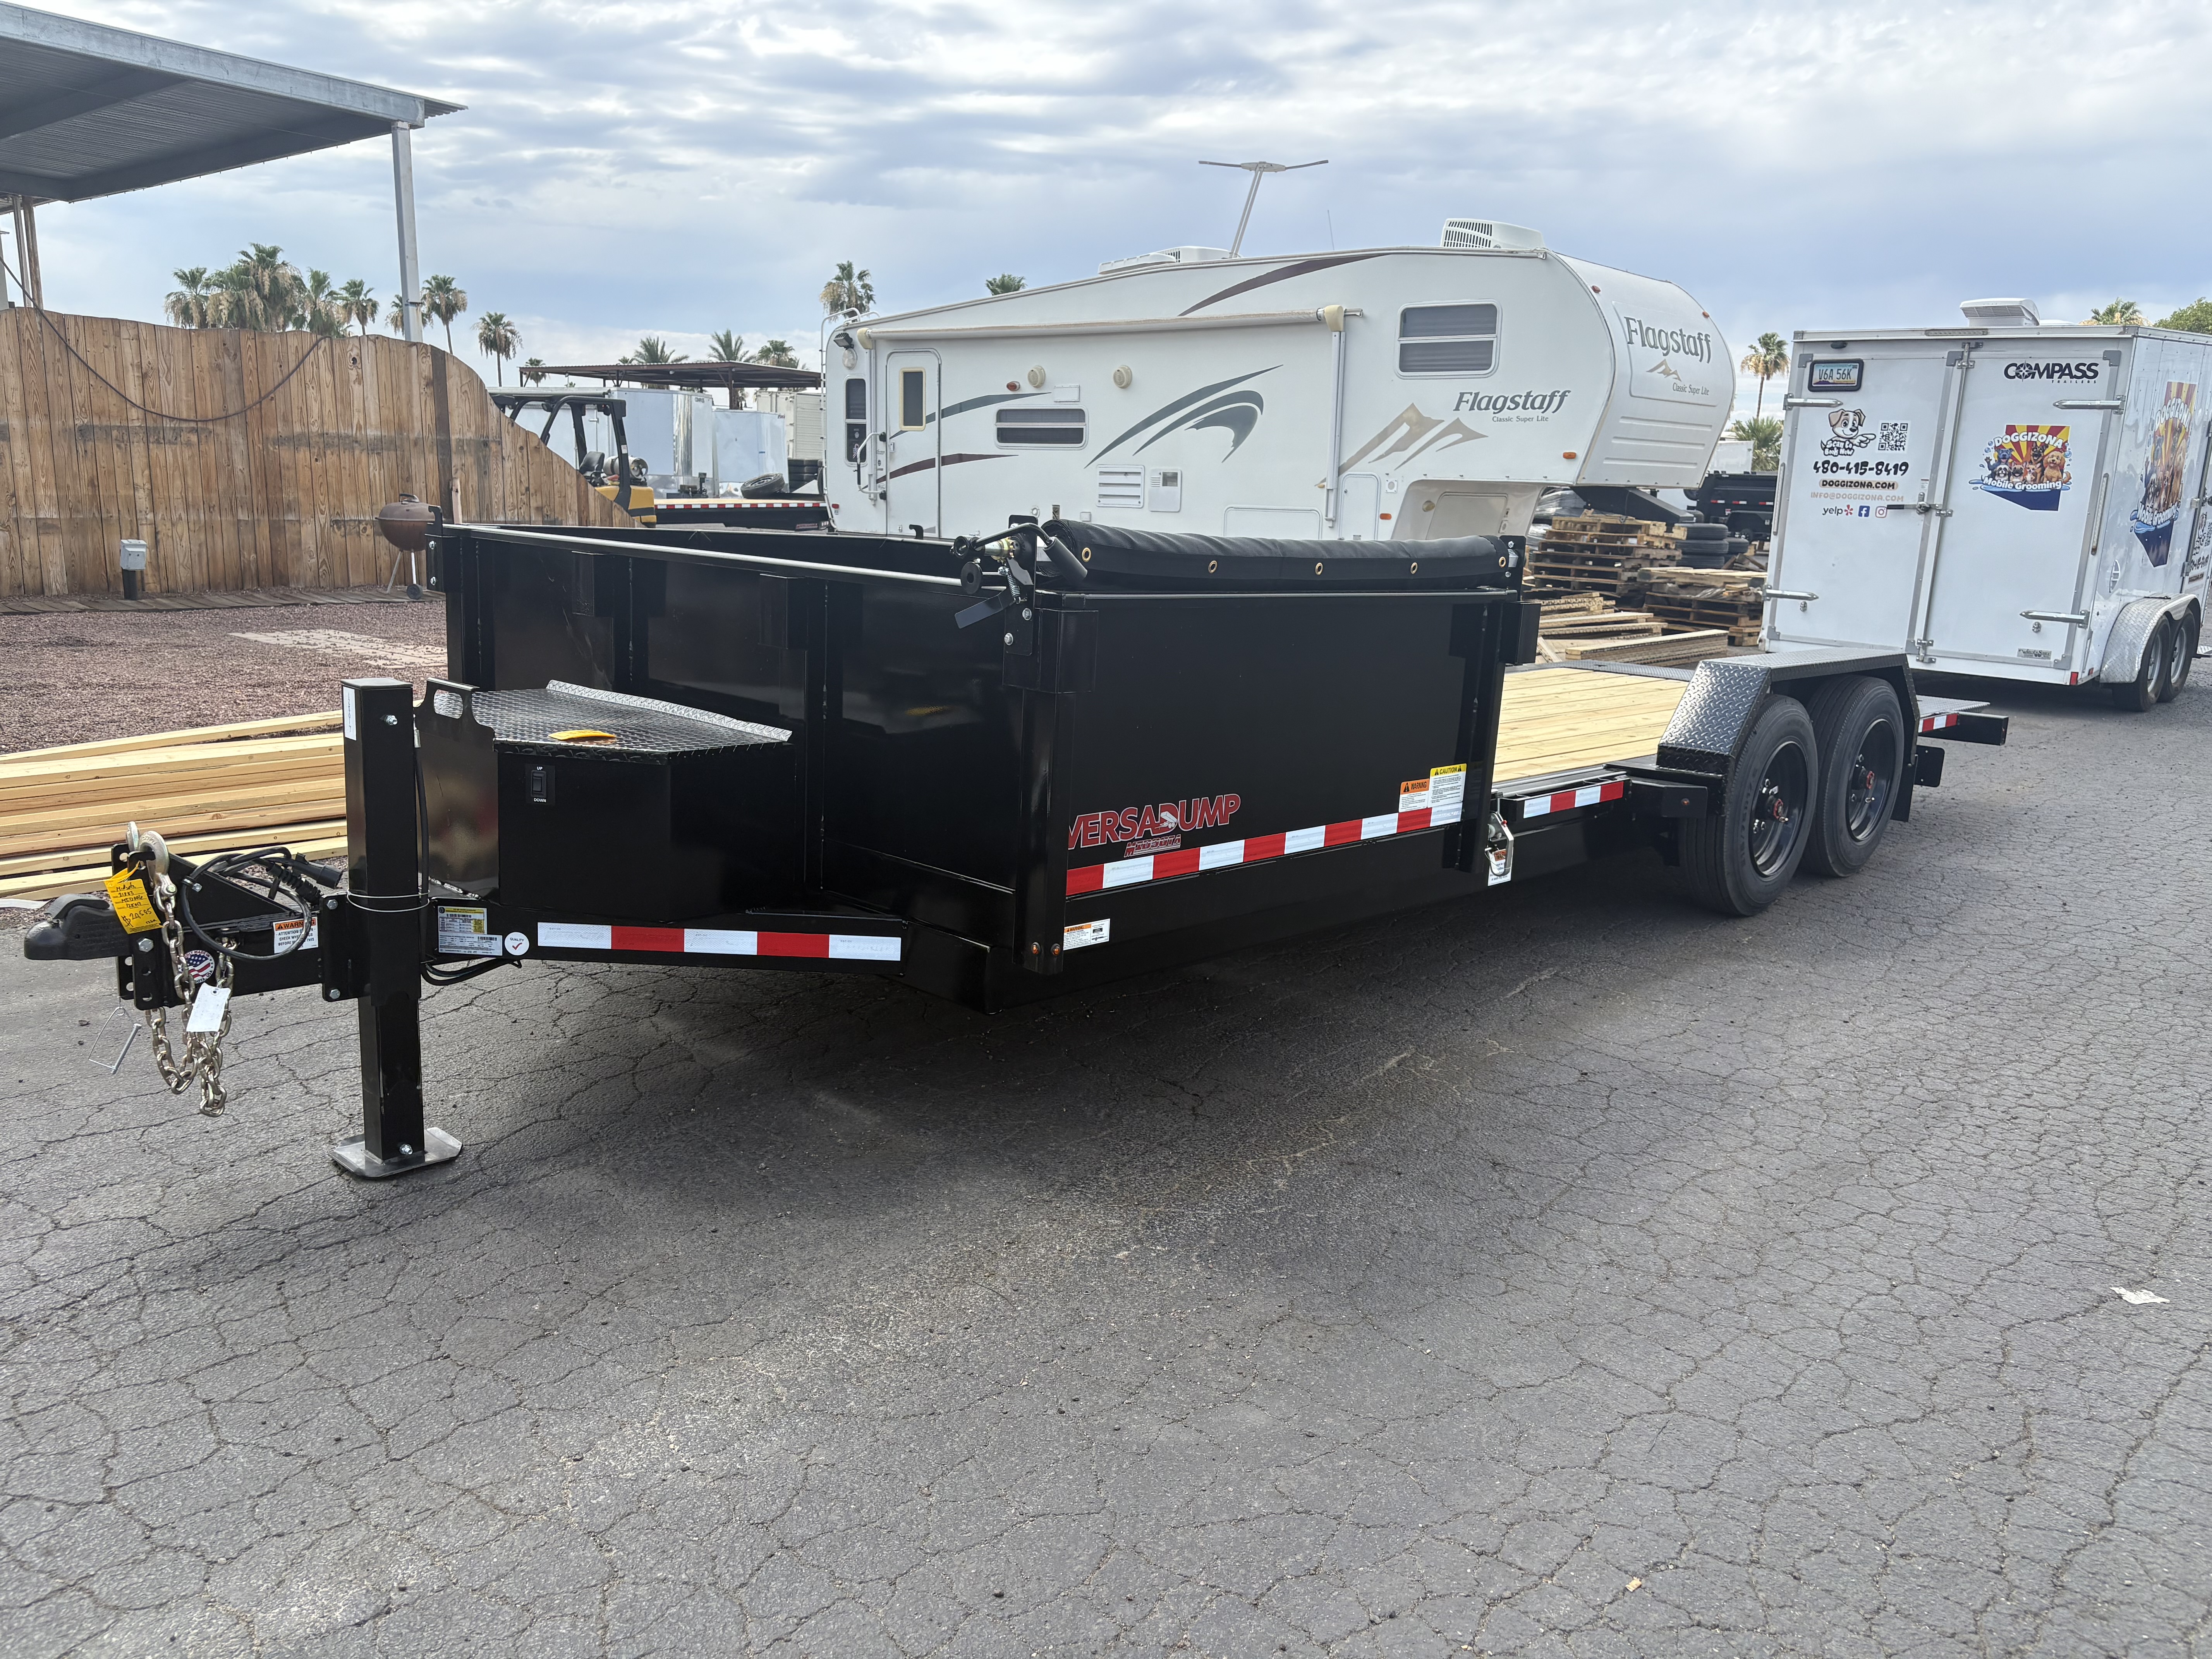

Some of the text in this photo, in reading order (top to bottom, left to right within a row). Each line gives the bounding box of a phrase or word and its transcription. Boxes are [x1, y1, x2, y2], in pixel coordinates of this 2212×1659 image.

[1624, 316, 1711, 364] Flagstaff
[1819, 368, 1852, 380] V6A 56K
[2004, 362, 2099, 380] COMPASS
[1673, 382, 1709, 395] Classic Super Lite
[1453, 390, 1571, 414] Flagstaff
[1994, 432, 2063, 449] DOGGIZONA
[1813, 460, 1909, 476] 480-415-8419
[1822, 480, 1895, 489] DOGGIZONA.COM
[1983, 477, 2062, 490] Mobile Grooming
[1811, 492, 1904, 501] INFO@DOGGIZONA.COM
[1822, 506, 1843, 516] yelp
[1411, 781, 1427, 790] WARNING
[1124, 834, 1181, 857] MIDSOTA
[283, 919, 314, 928] WARNG
